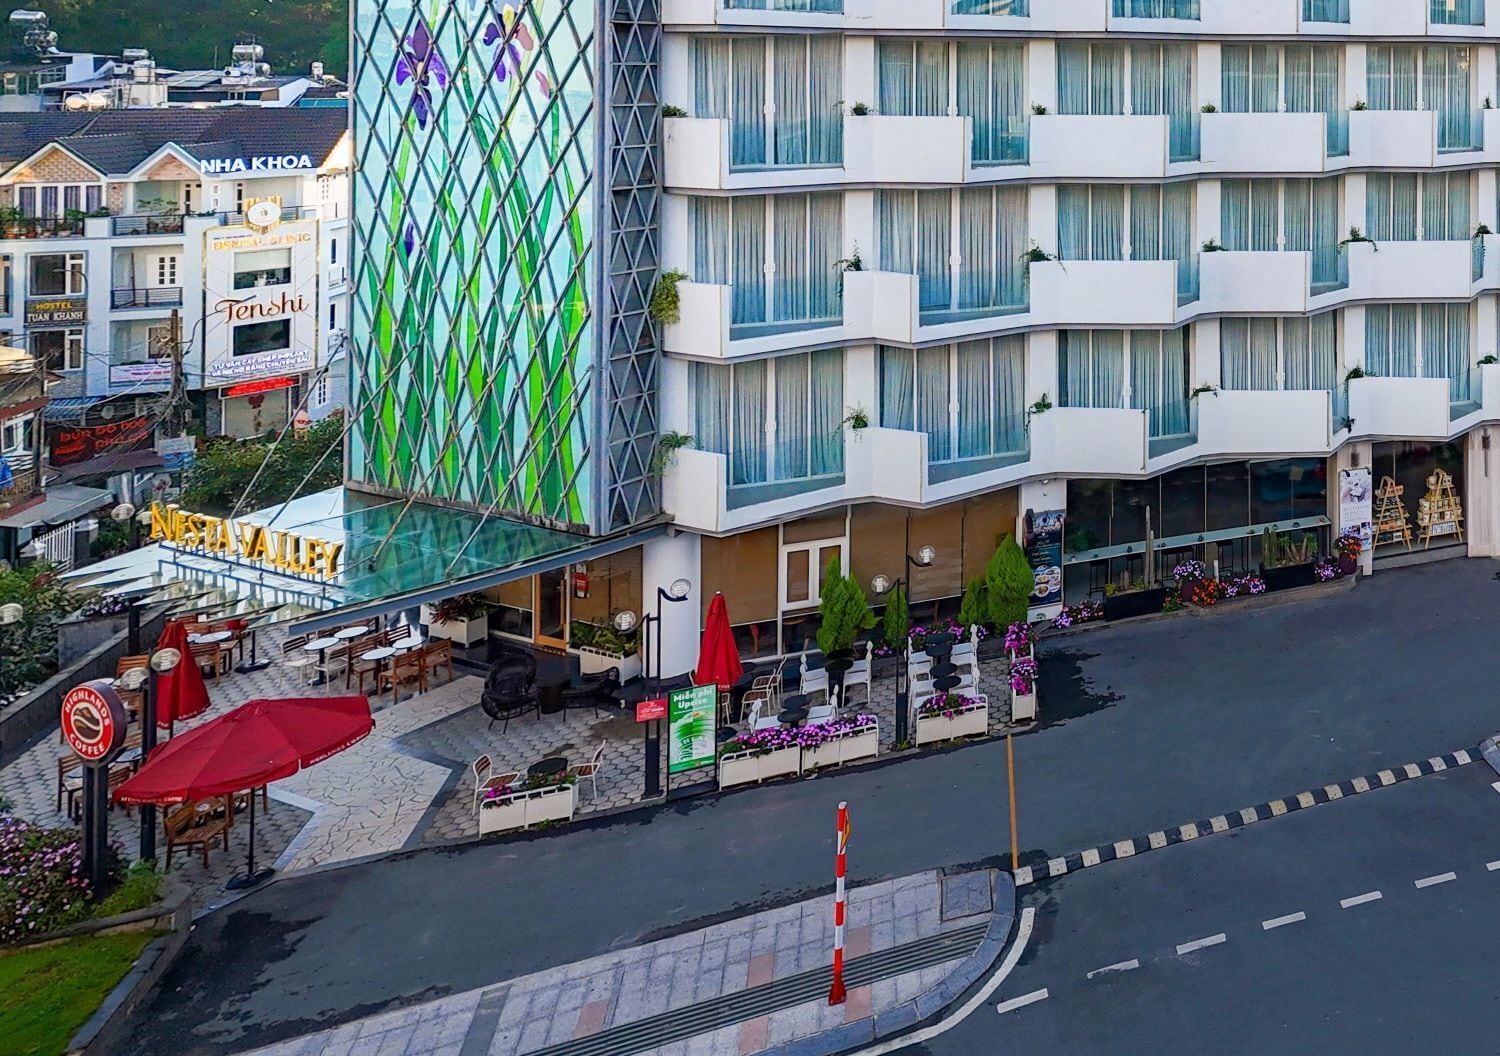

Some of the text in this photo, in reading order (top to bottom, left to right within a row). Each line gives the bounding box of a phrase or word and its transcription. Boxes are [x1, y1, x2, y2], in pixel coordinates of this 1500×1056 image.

[200, 154, 312, 173] NHA KHOA
[215, 292, 310, 324] Tenshi
[150, 500, 344, 578] NESTA VALLEY
[65, 690, 110, 727] HIGHLANDS
[69, 733, 105, 755] COFFEE
